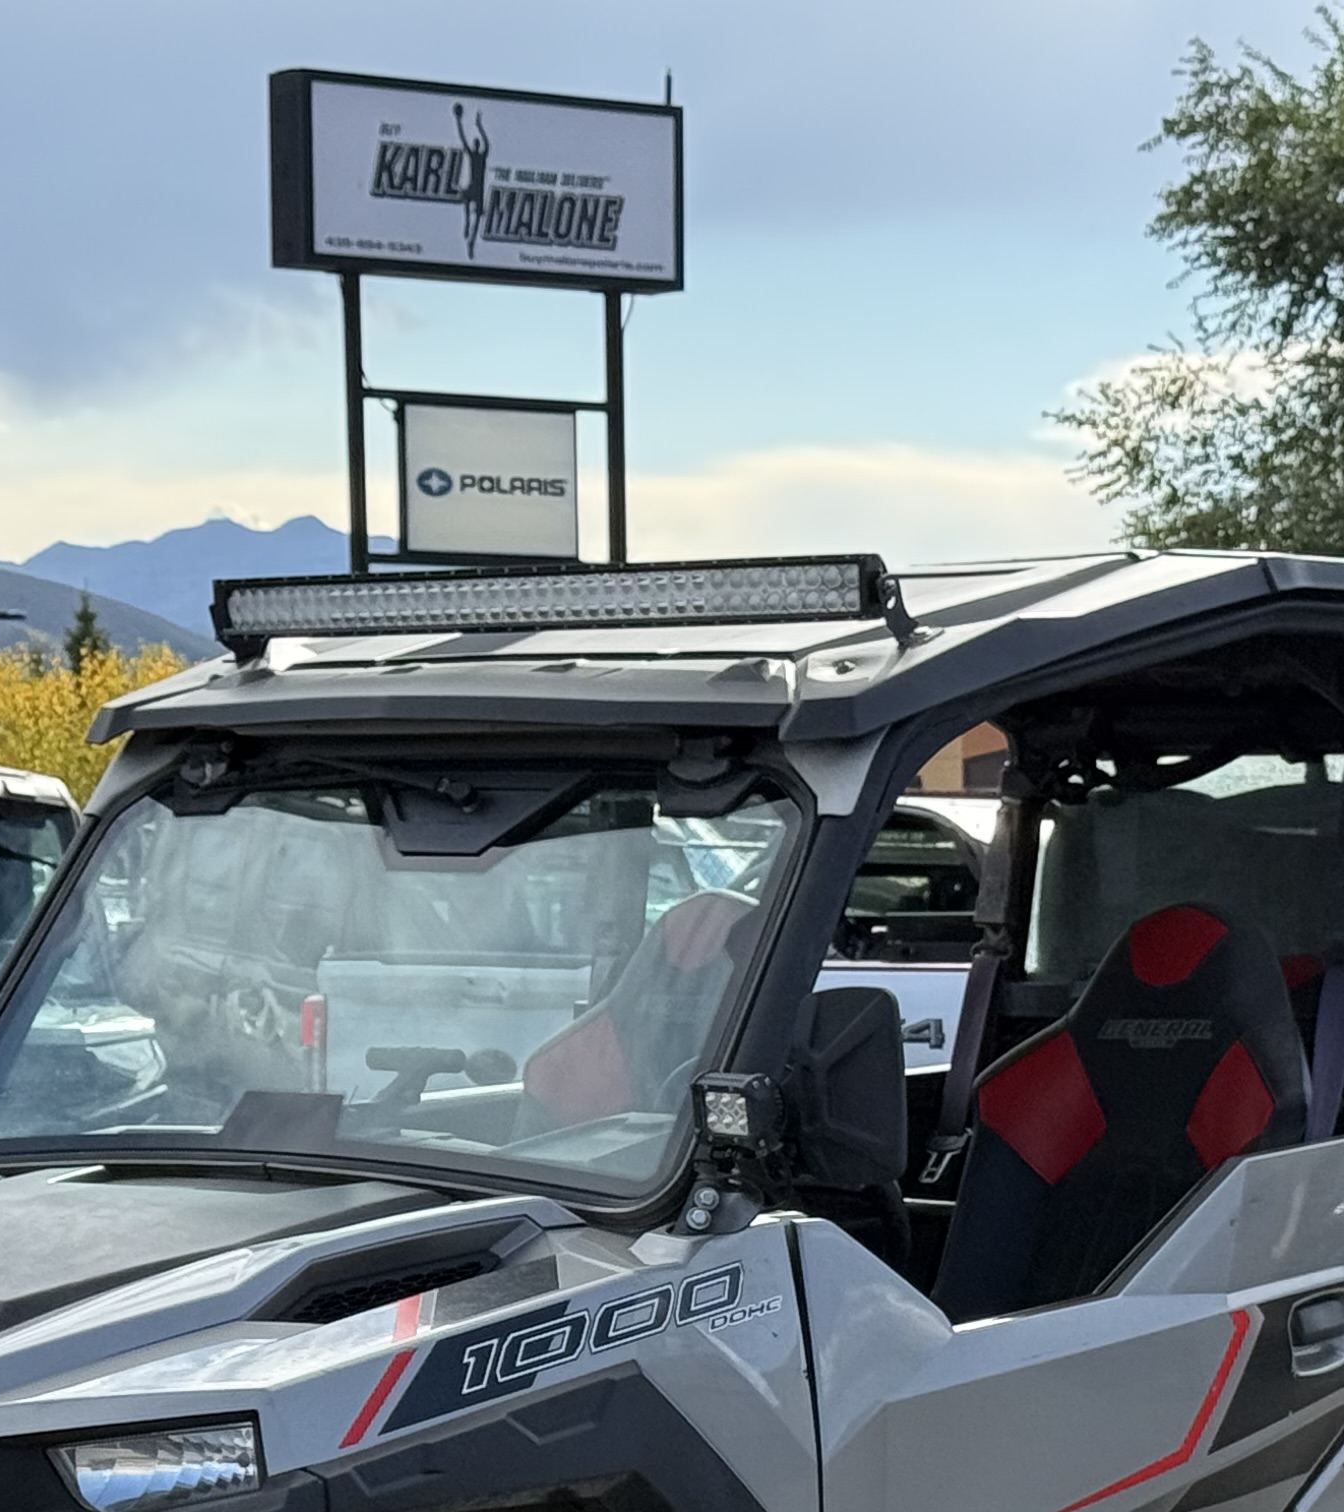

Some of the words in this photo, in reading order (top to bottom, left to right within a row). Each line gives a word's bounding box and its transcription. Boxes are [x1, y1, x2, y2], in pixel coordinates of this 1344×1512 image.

[373, 142, 464, 201] KARL
[483, 187, 624, 249] MALONE
[459, 473, 567, 497] POLARIS
[462, 1261, 744, 1394] 1000
[709, 1295, 783, 1333] DOHC
